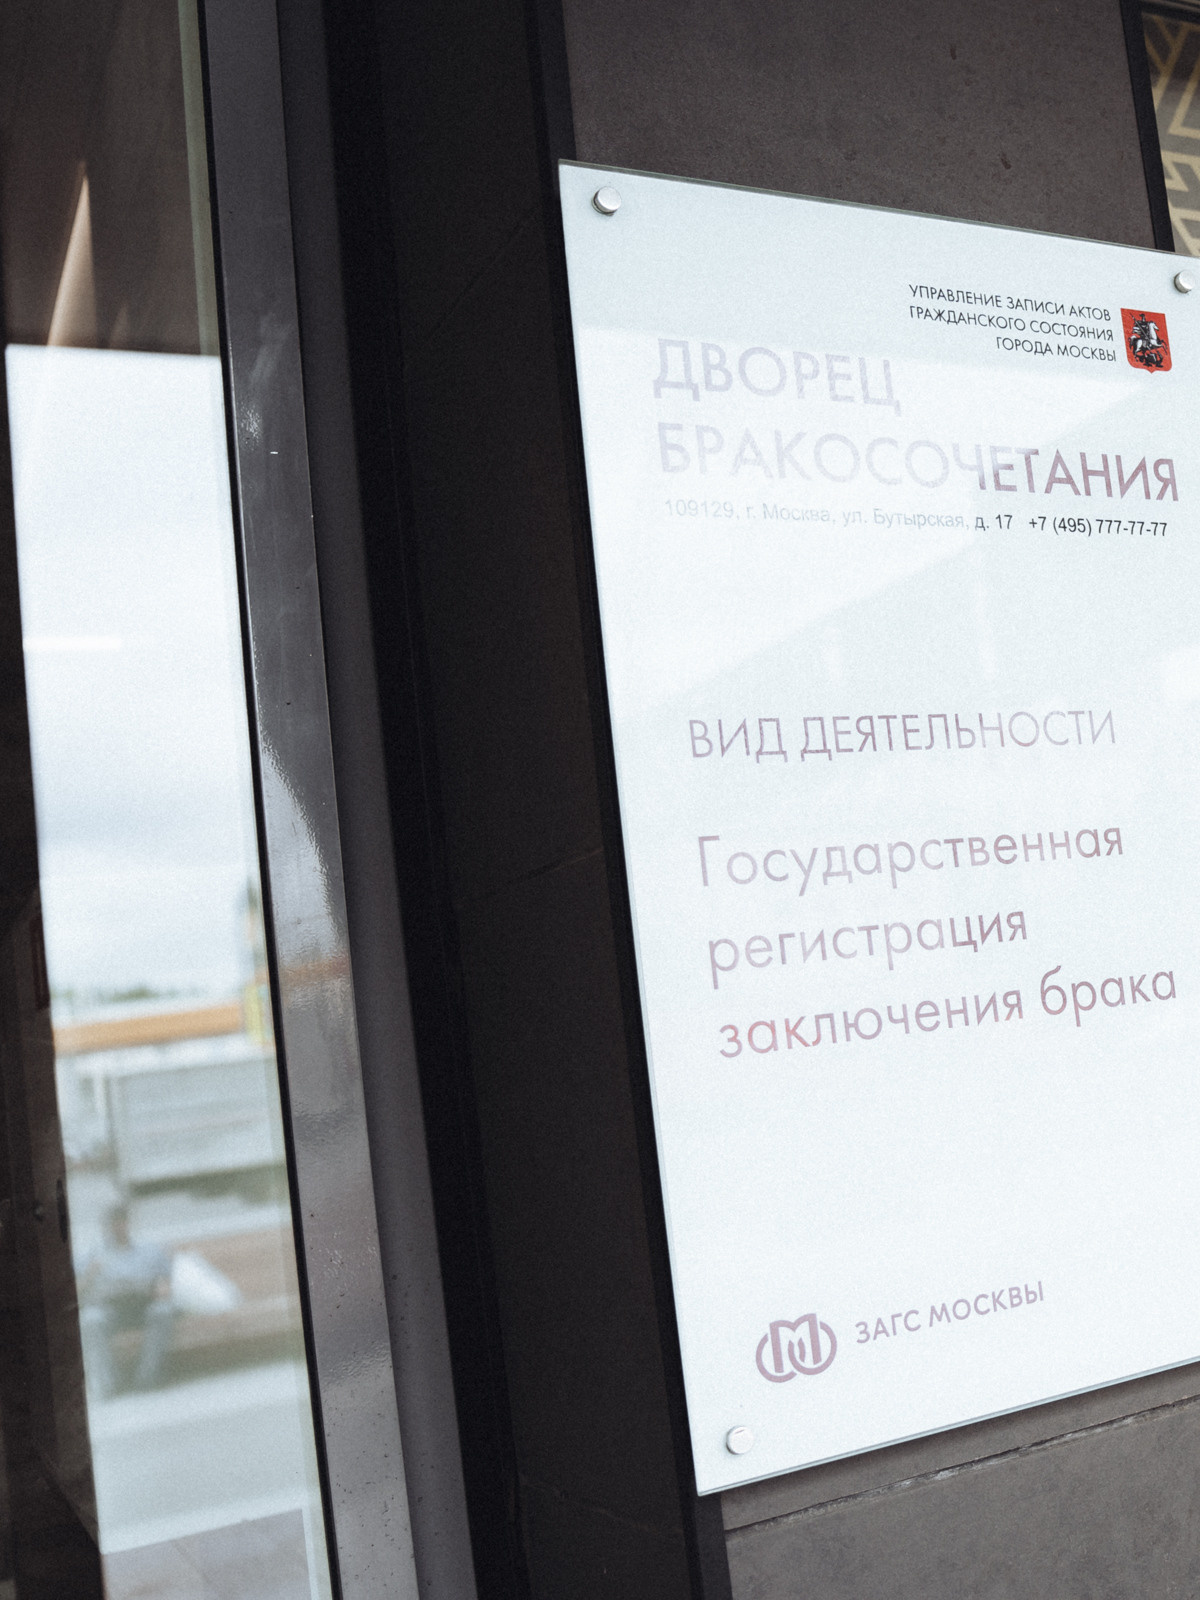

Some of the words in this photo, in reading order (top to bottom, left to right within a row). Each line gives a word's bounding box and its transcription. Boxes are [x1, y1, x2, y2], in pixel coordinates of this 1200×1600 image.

[909, 285, 1002, 308] УПРАВЛЕНИЕ
[1006, 297, 1066, 315] ЗАПИСИ
[1069, 306, 1112, 321] АКТОВ
[909, 306, 1026, 331] ГРАЖДАНСКОГО
[1030, 320, 1115, 341] СОСТОЯНИЯ
[653, 338, 902, 416] ДВОРЕЦ
[996, 337, 1054, 356] ГОРОДА
[1057, 345, 1117, 362] МОСКВЫ
[657, 422, 1179, 502] БРАКОСОЧЕТАНИЯ
[763, 503, 836, 525] Москва,
[842, 508, 867, 528] ул.
[873, 508, 970, 531] Бутырская,
[975, 516, 989, 532] д.
[995, 514, 1013, 530] 17
[1029, 516, 1047, 531] +7
[1052, 517, 1092, 537] (495)
[1095, 519, 1168, 537] 777-77-77
[689, 718, 788, 763] ВИД
[800, 710, 1116, 761] ДЕЯТЕЛЬНОСТИ
[697, 827, 1124, 897] Государственная
[708, 911, 1028, 990] регистрация
[718, 990, 1025, 1059] заключения
[1039, 965, 1177, 1027] брака
[855, 1309, 922, 1344] ЗАГС
[928, 1281, 1044, 1328] МОСКВЫ
